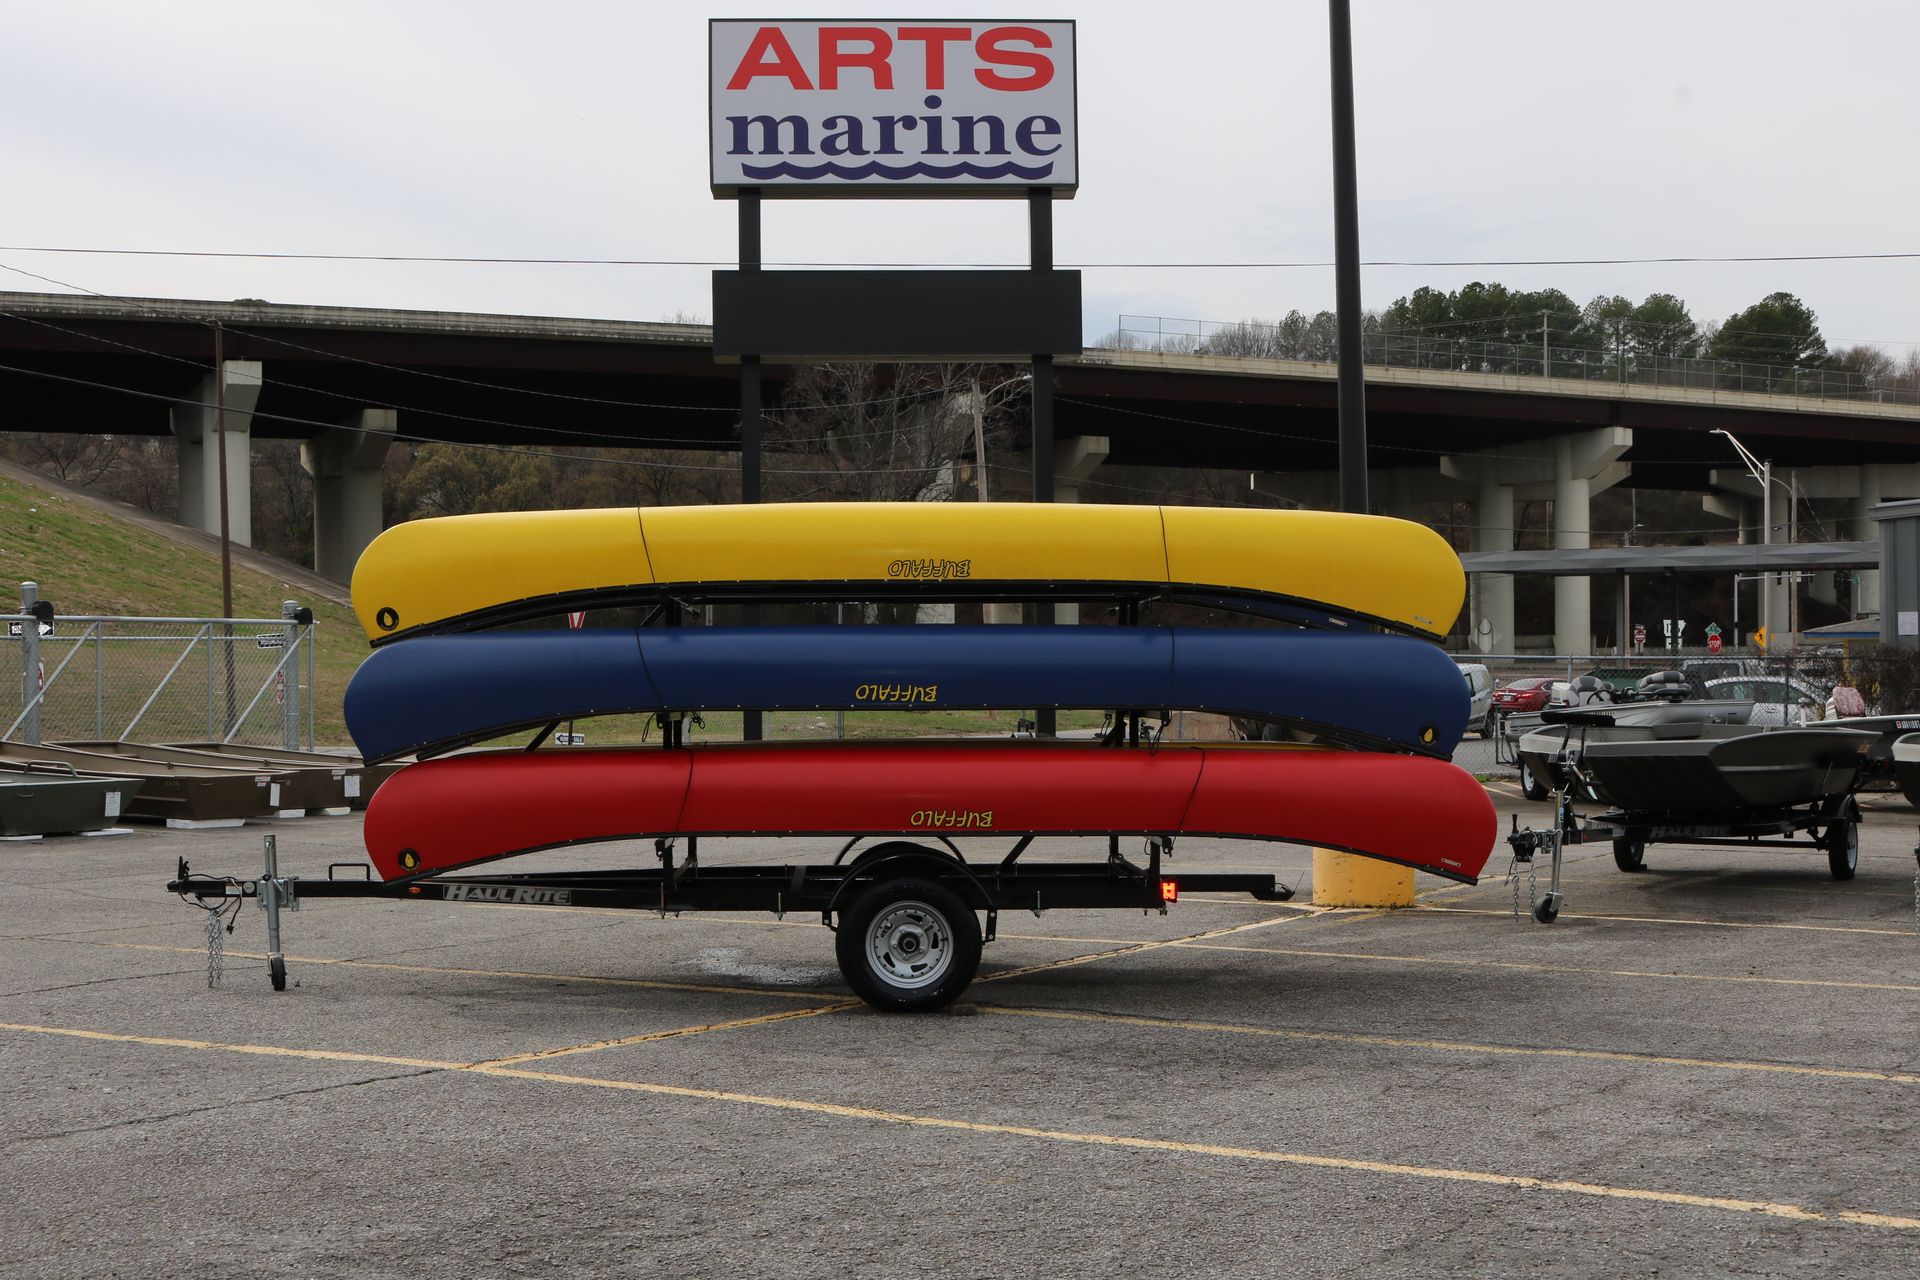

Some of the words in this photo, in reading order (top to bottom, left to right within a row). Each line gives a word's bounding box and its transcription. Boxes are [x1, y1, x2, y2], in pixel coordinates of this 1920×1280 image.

[725, 26, 1055, 92] ARTS
[725, 95, 1063, 156] marine
[887, 558, 971, 579] BUFFALO
[1708, 639, 1721, 648] STOP
[855, 684, 938, 703] BUFFALO
[910, 809, 993, 828] BUFFALO
